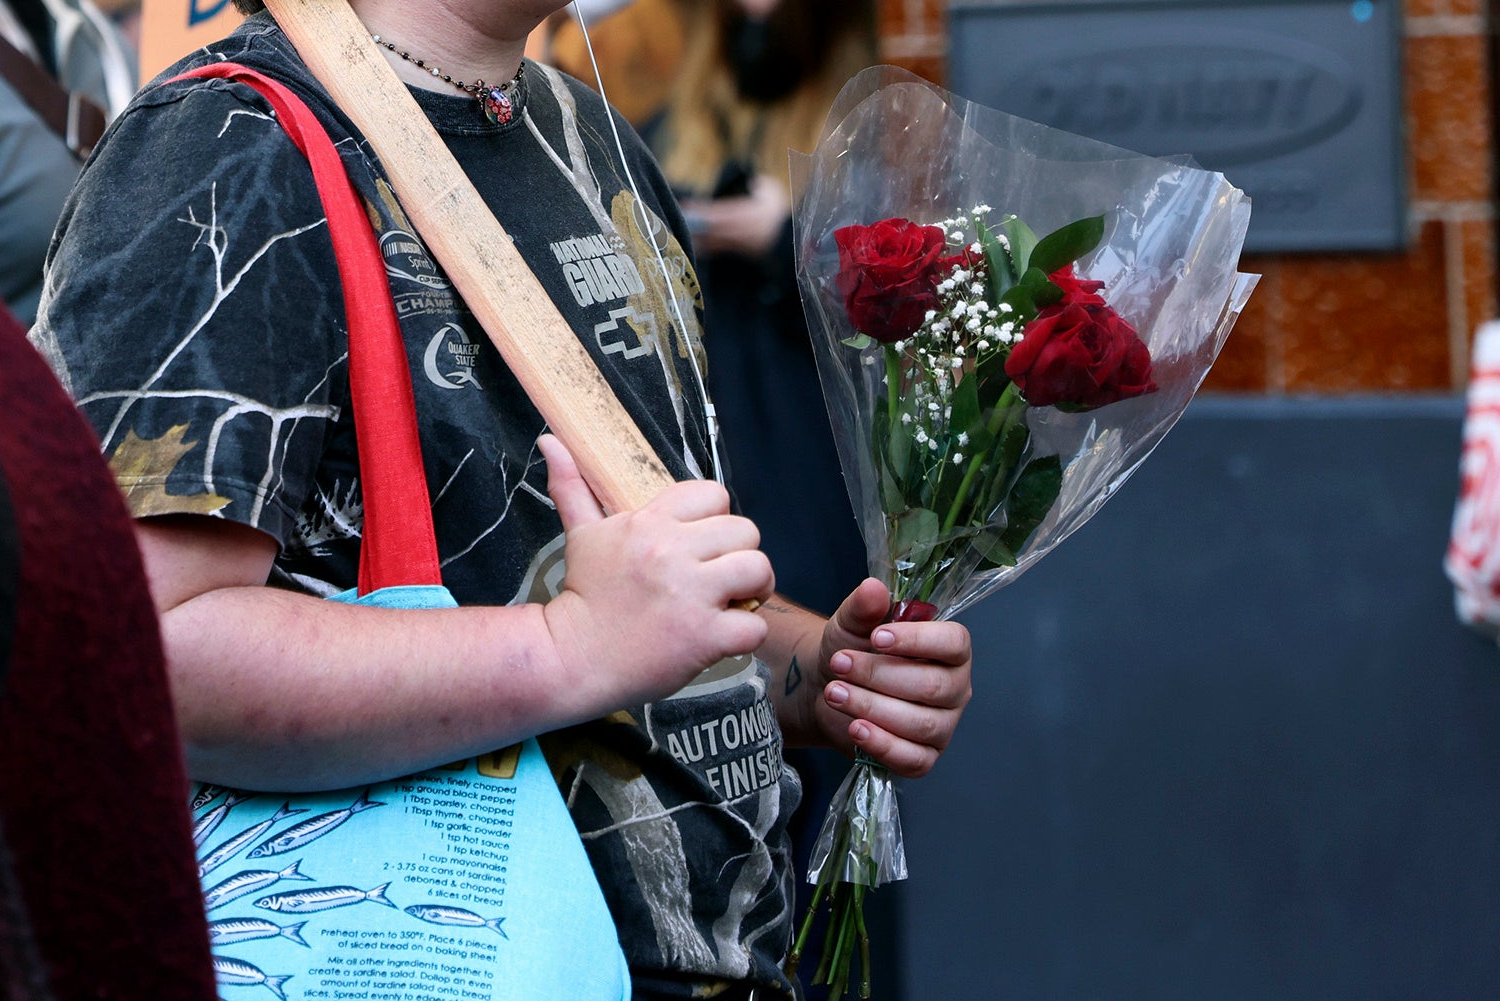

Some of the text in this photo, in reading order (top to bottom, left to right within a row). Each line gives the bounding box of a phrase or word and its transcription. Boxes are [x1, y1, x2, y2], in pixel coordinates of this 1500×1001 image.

[550, 233, 615, 265] NATIONAL
[562, 253, 646, 308] GUARD
[396, 298, 455, 314] CHAMP
[448, 341, 480, 355] QUAKER
[455, 355, 476, 367] STATE
[447, 776, 471, 789] finely
[473, 781, 517, 794] chopped
[417, 786, 450, 796] ground
[452, 788, 478, 800] black
[480, 795, 516, 805] pepper
[410, 795, 431, 806] Tbsp
[433, 797, 468, 810] parsley,
[470, 802, 514, 817] chopped
[412, 806, 432, 817] Tbsp
[435, 808, 465, 821] thyme,
[468, 814, 513, 828] chopped
[431, 820, 444, 830] tsp
[447, 822, 472, 832] garlic
[474, 827, 512, 839] powder
[448, 833, 461, 844] tsp
[463, 836, 478, 845] hot
[481, 840, 510, 850] sauce
[454, 846, 467, 855] tsp
[470, 848, 509, 863] ketchup
[383, 862, 390, 870] 2
[397, 862, 416, 872] 3.75
[431, 866, 454, 876] cans
[456, 868, 466, 877] of
[428, 855, 448, 865] cup
[450, 858, 507, 874] mayonnaise
[404, 874, 505, 896] deboned & chopped
[428, 888, 503, 908] 6 slices of bread
[321, 928, 359, 938] Preheat
[388, 930, 398, 939] to
[429, 934, 455, 944] Place
[466, 940, 498, 952] pieces
[338, 940, 348, 948] of
[350, 941, 377, 950] sliced
[380, 942, 409, 951] bread
[435, 946, 468, 960] baking
[470, 951, 498, 964] sheet.
[327, 956, 494, 980] Mix all other ingredients together to
[308, 967, 341, 976] create
[353, 969, 388, 978] sardine
[420, 972, 450, 984] Dollop
[453, 978, 466, 986] an
[468, 980, 492, 990] even
[304, 989, 330, 998] slices.
[334, 990, 368, 1000] Spread
[370, 991, 402, 1001] evenly
[404, 992, 414, 1001] to
[320, 980, 358, 988] amount
[360, 980, 370, 988] of
[373, 980, 407, 990] sardine
[409, 982, 435, 992] salad
[437, 986, 460, 996] onto
[462, 989, 492, 1001] bread
